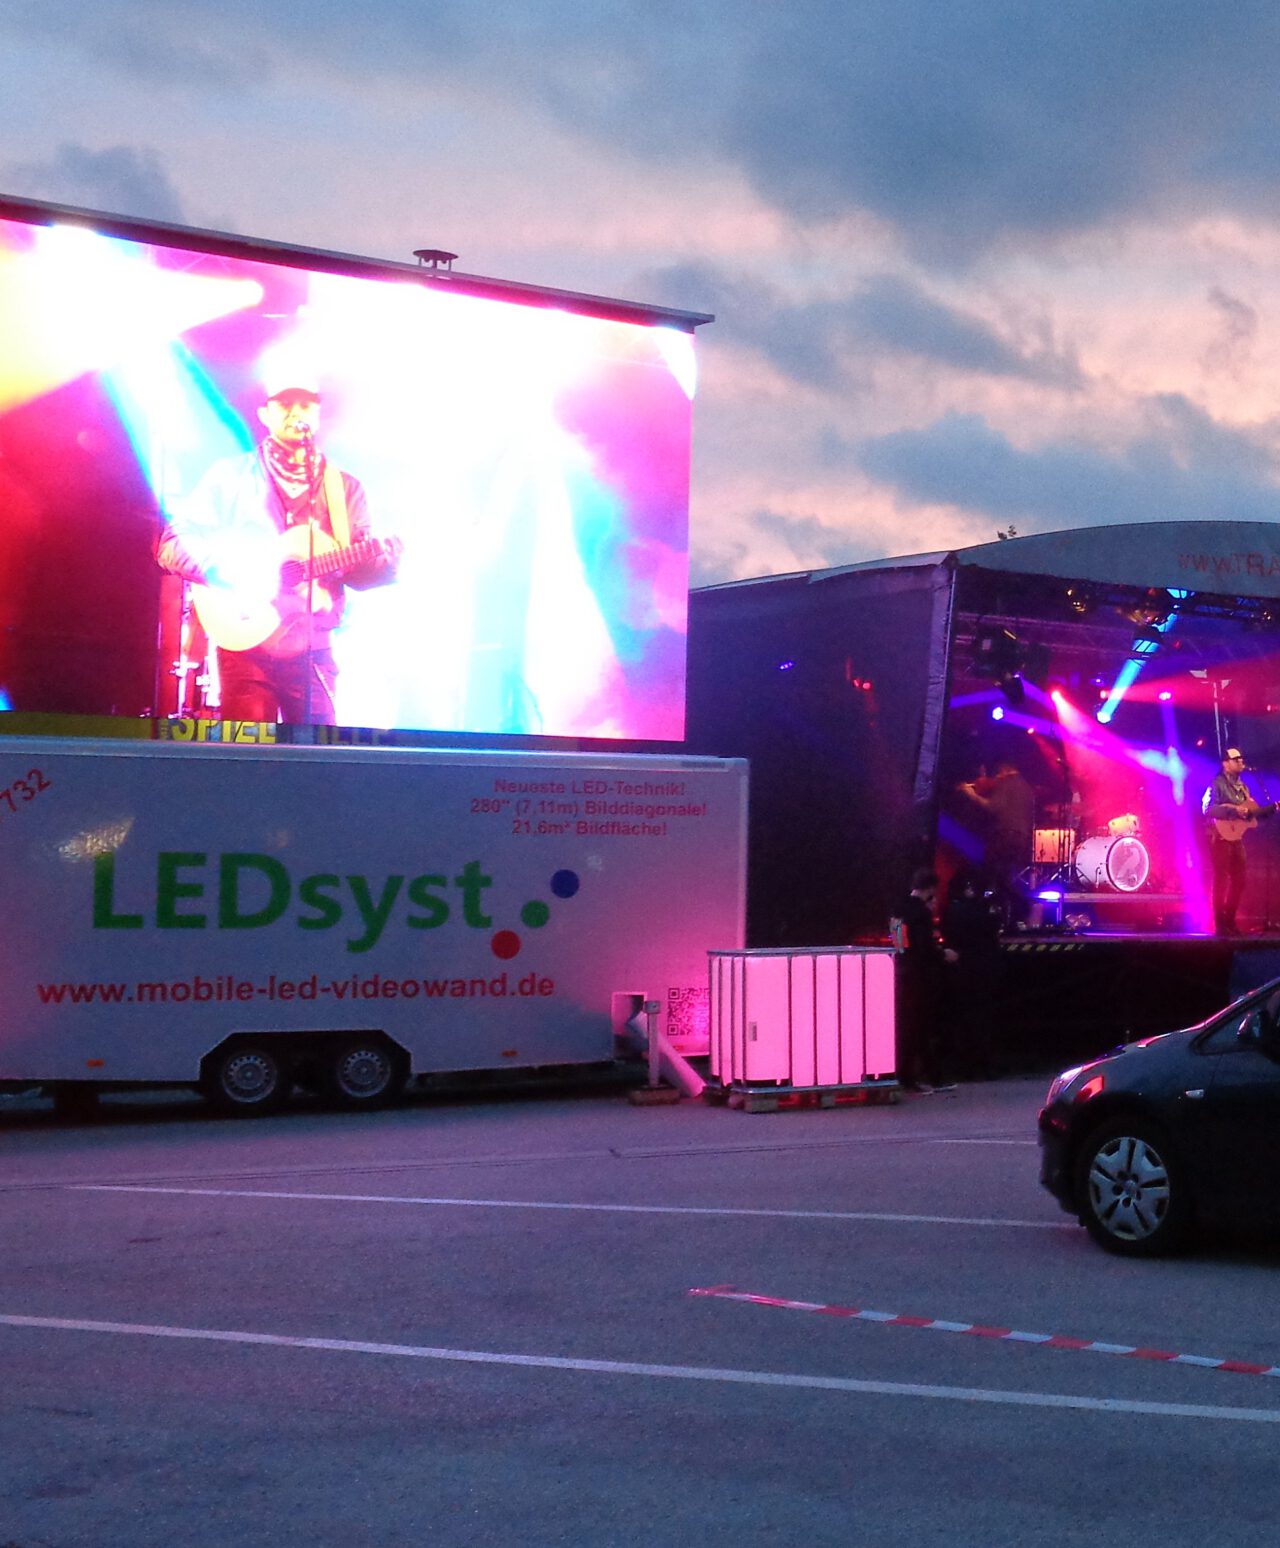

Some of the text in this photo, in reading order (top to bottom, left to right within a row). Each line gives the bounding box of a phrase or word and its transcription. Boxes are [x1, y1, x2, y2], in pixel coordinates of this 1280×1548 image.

[494, 780, 686, 796] Neueste LED-Technik!
[584, 801, 708, 819] Bilddiagonale!
[576, 820, 668, 836] Bildfläche!
[37, 972, 555, 1003] www.mobile-led-videowand.de
